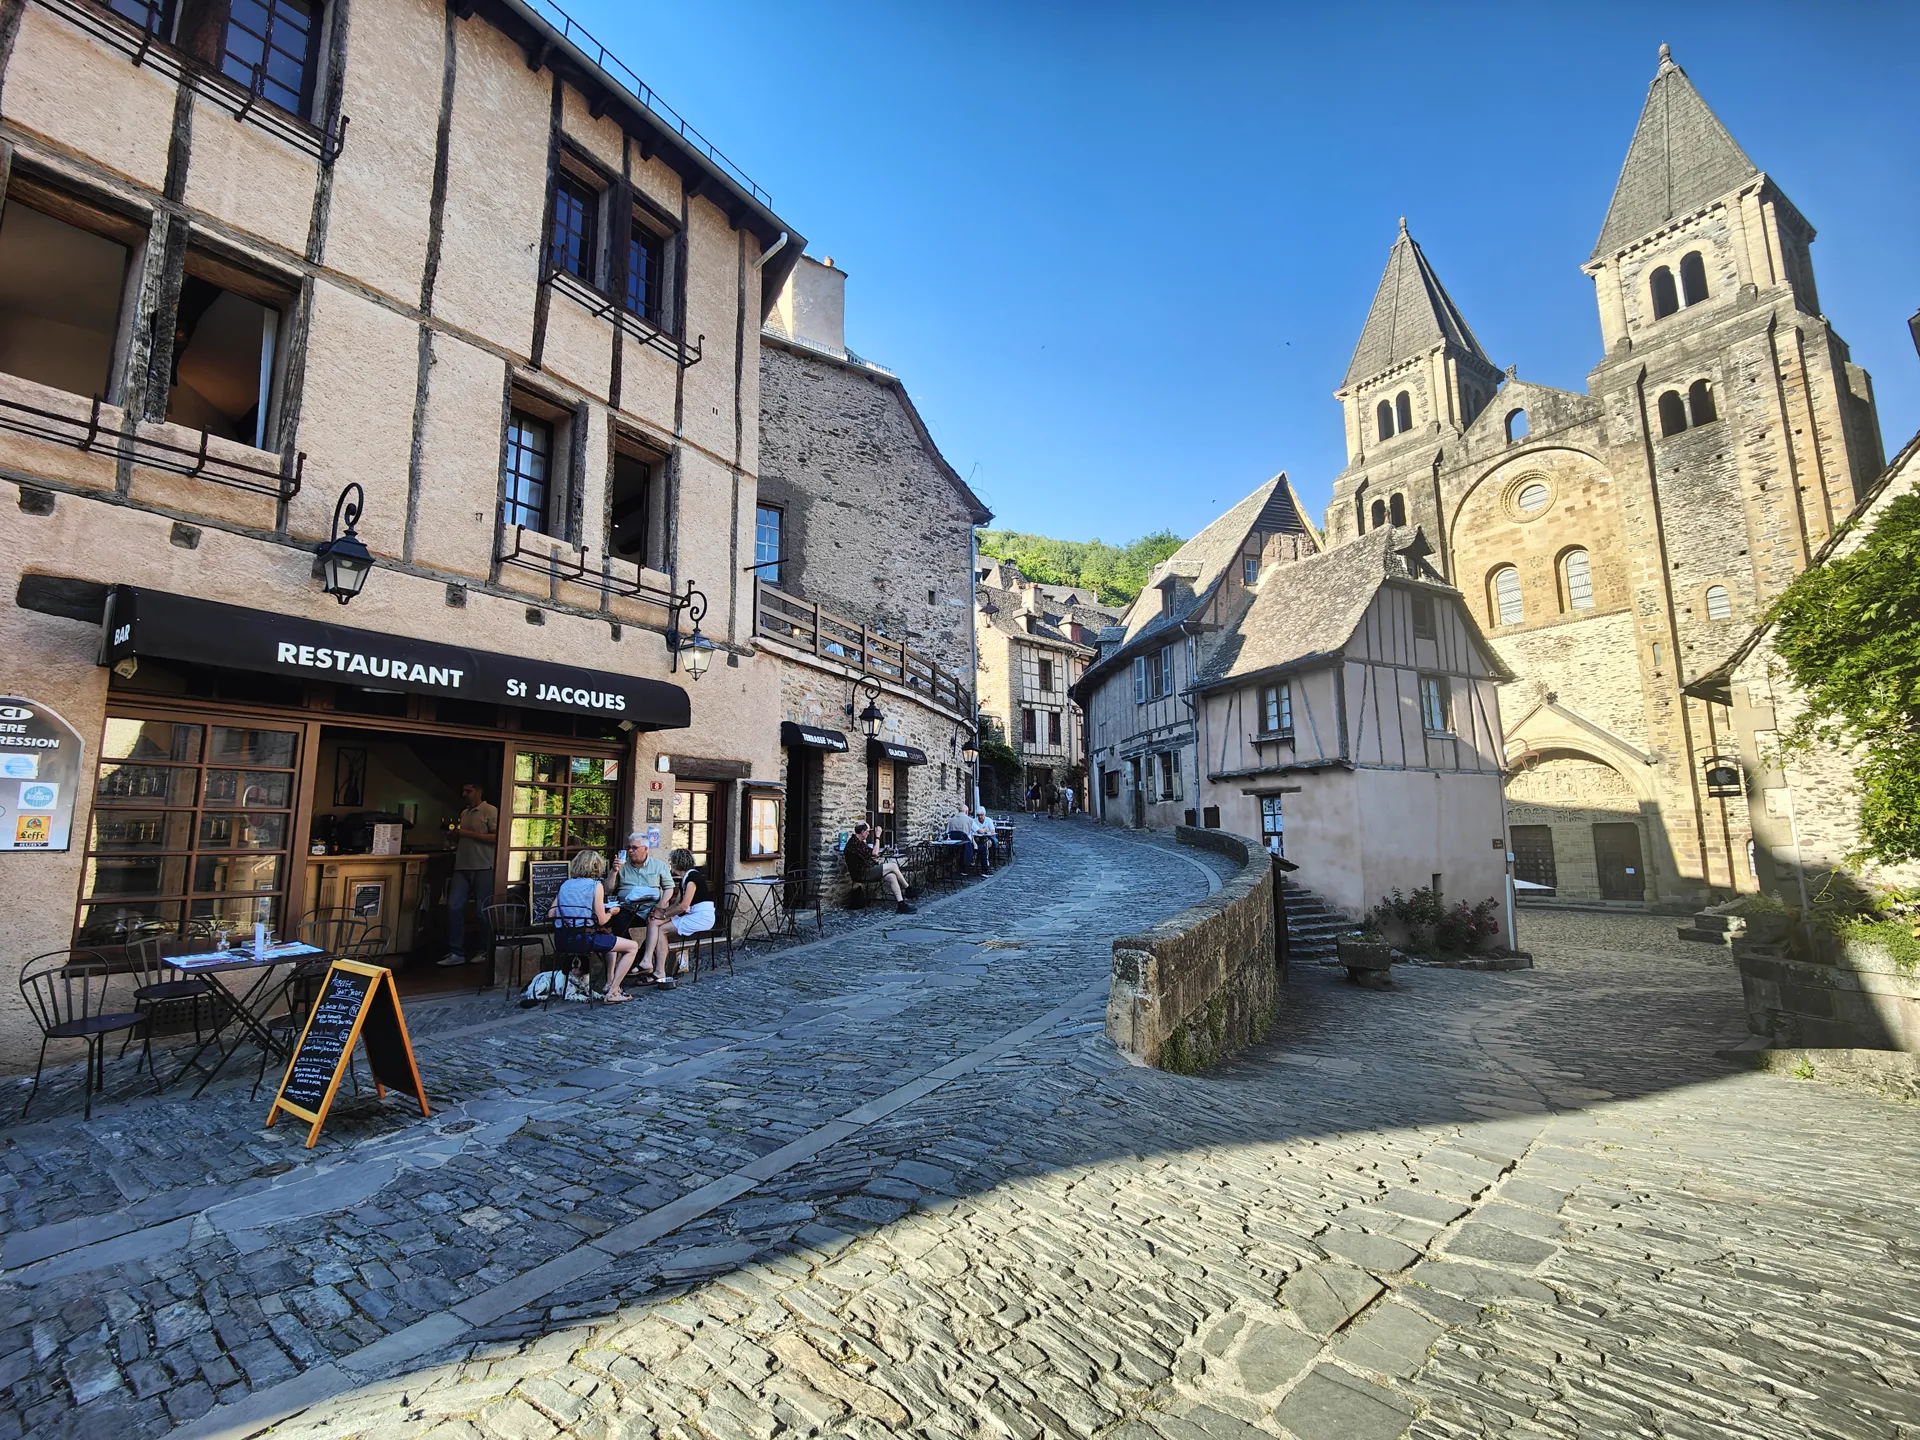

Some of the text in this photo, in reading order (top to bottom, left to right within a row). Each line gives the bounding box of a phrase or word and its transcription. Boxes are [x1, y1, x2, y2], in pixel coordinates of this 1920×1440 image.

[113, 623, 131, 646] BAR
[277, 641, 464, 689] RESTAURANT
[506, 678, 626, 711] St JACQUES
[802, 733, 826, 745] TERRASSE
[888, 748, 908, 758] GLACIER
[654, 782, 660, 790] 8
[19, 830, 45, 841] Leffe
